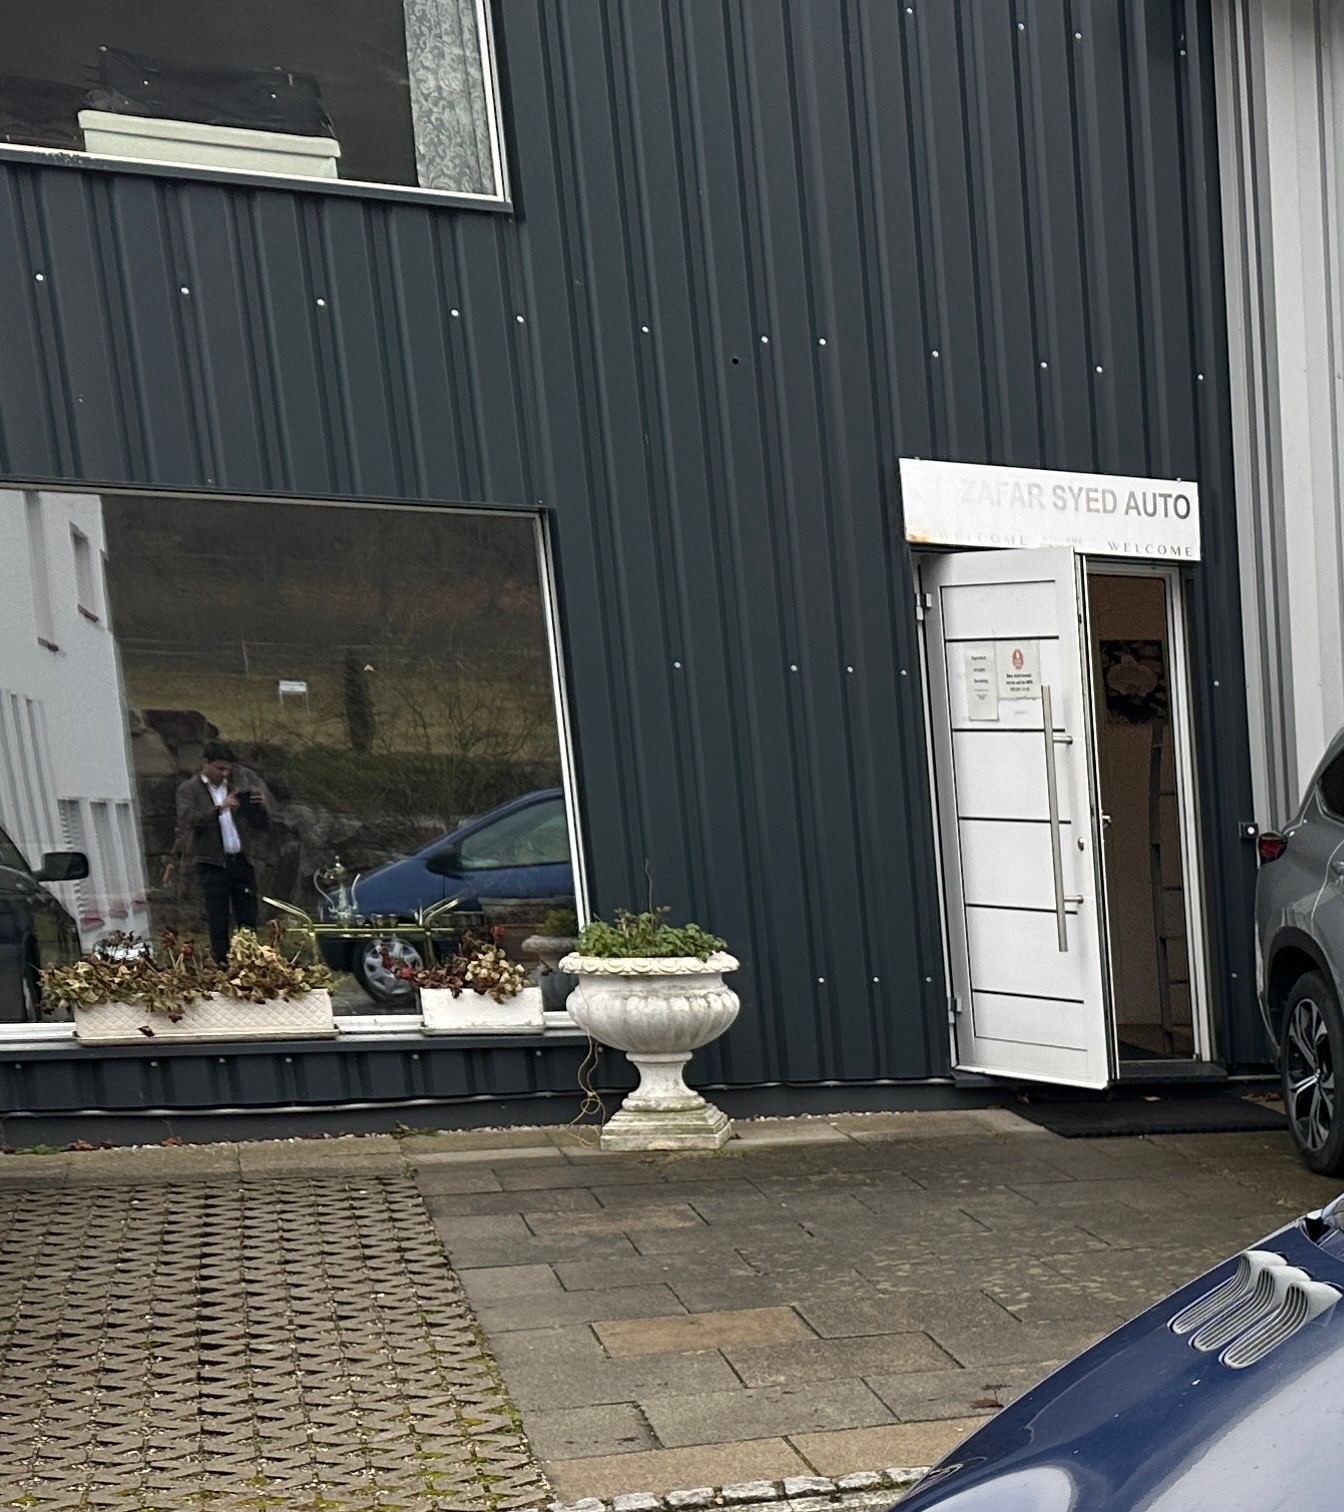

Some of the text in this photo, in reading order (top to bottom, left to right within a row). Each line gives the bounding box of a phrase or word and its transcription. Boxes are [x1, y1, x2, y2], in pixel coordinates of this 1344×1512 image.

[960, 477, 1192, 520] ZAFAR SYED AUTO
[1107, 541, 1193, 557] WELCOME
